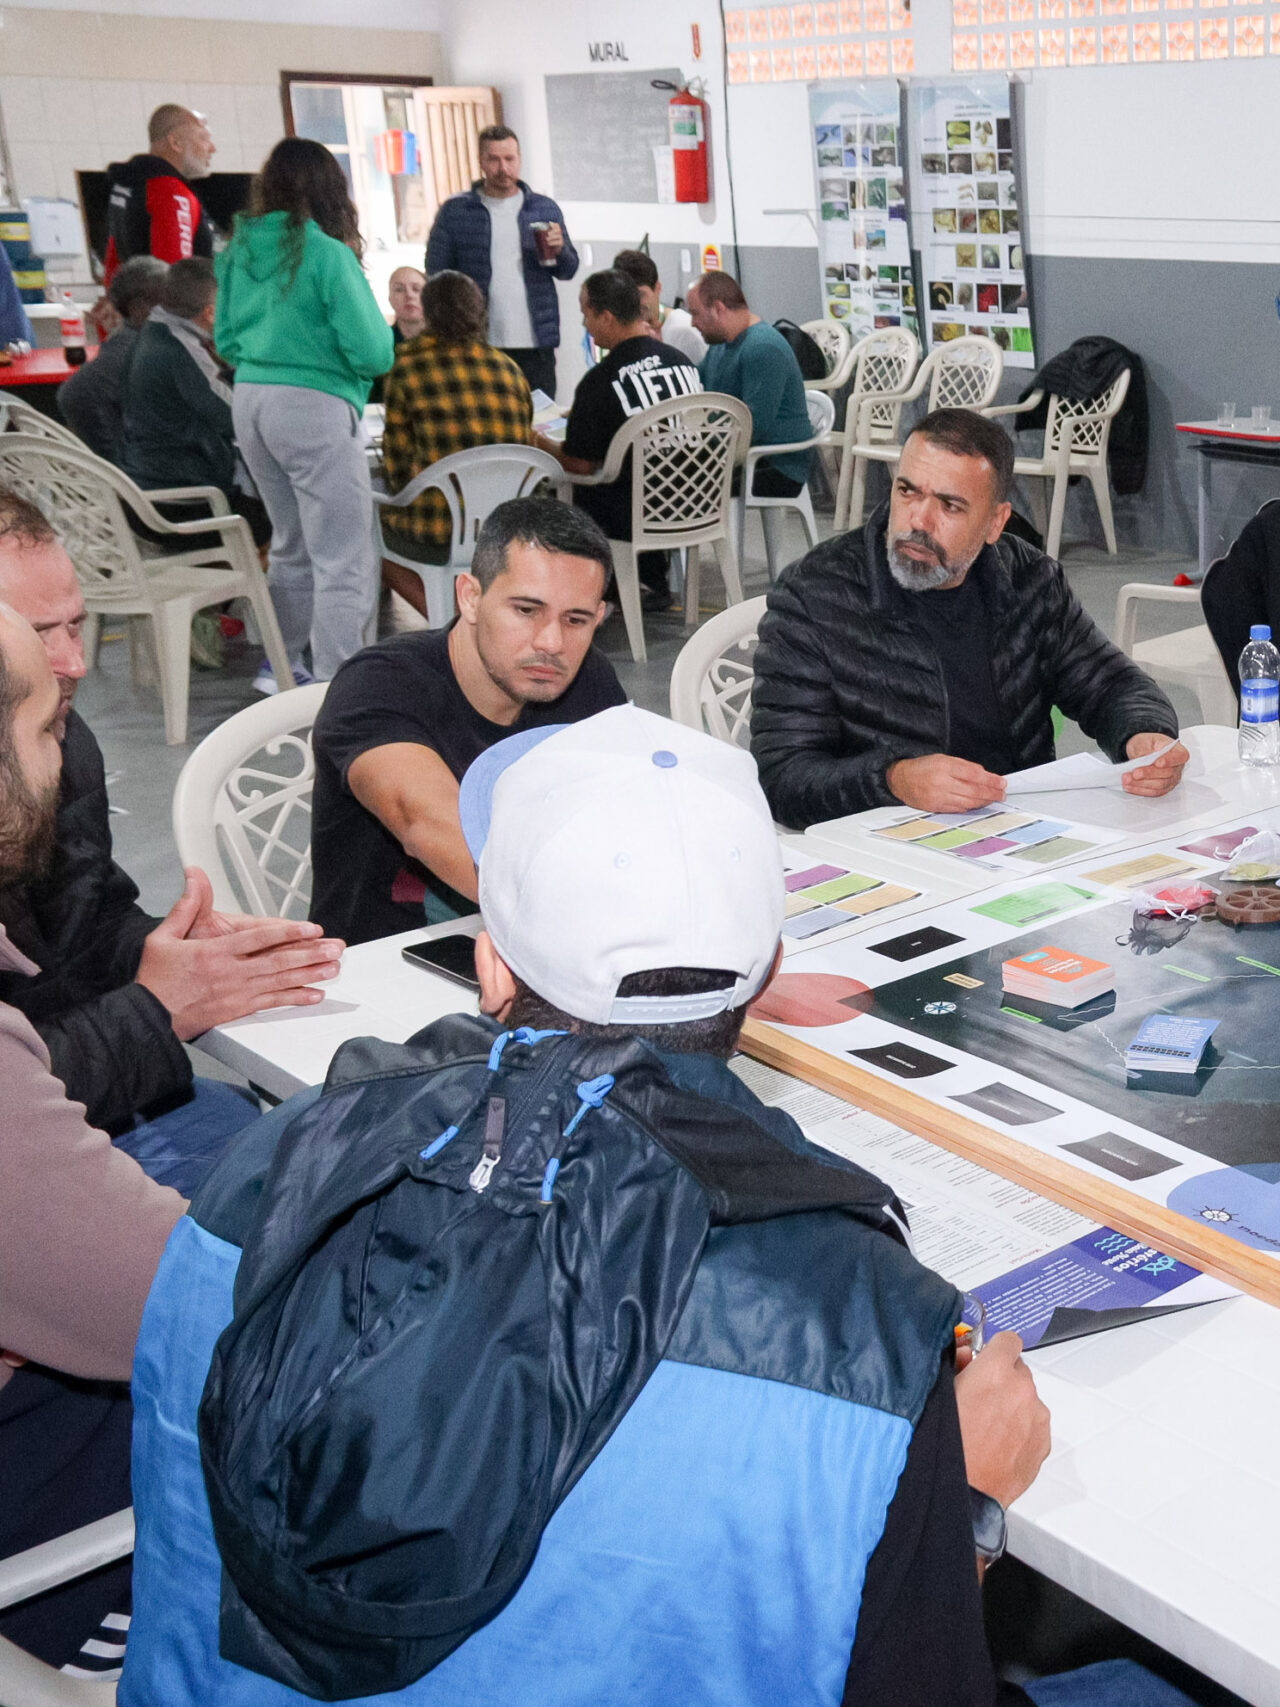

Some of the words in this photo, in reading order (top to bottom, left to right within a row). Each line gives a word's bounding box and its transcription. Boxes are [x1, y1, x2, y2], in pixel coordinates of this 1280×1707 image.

[588, 41, 629, 63] MURAL
[618, 355, 663, 383] POWER
[1112, 1247, 1158, 1273] stérios
